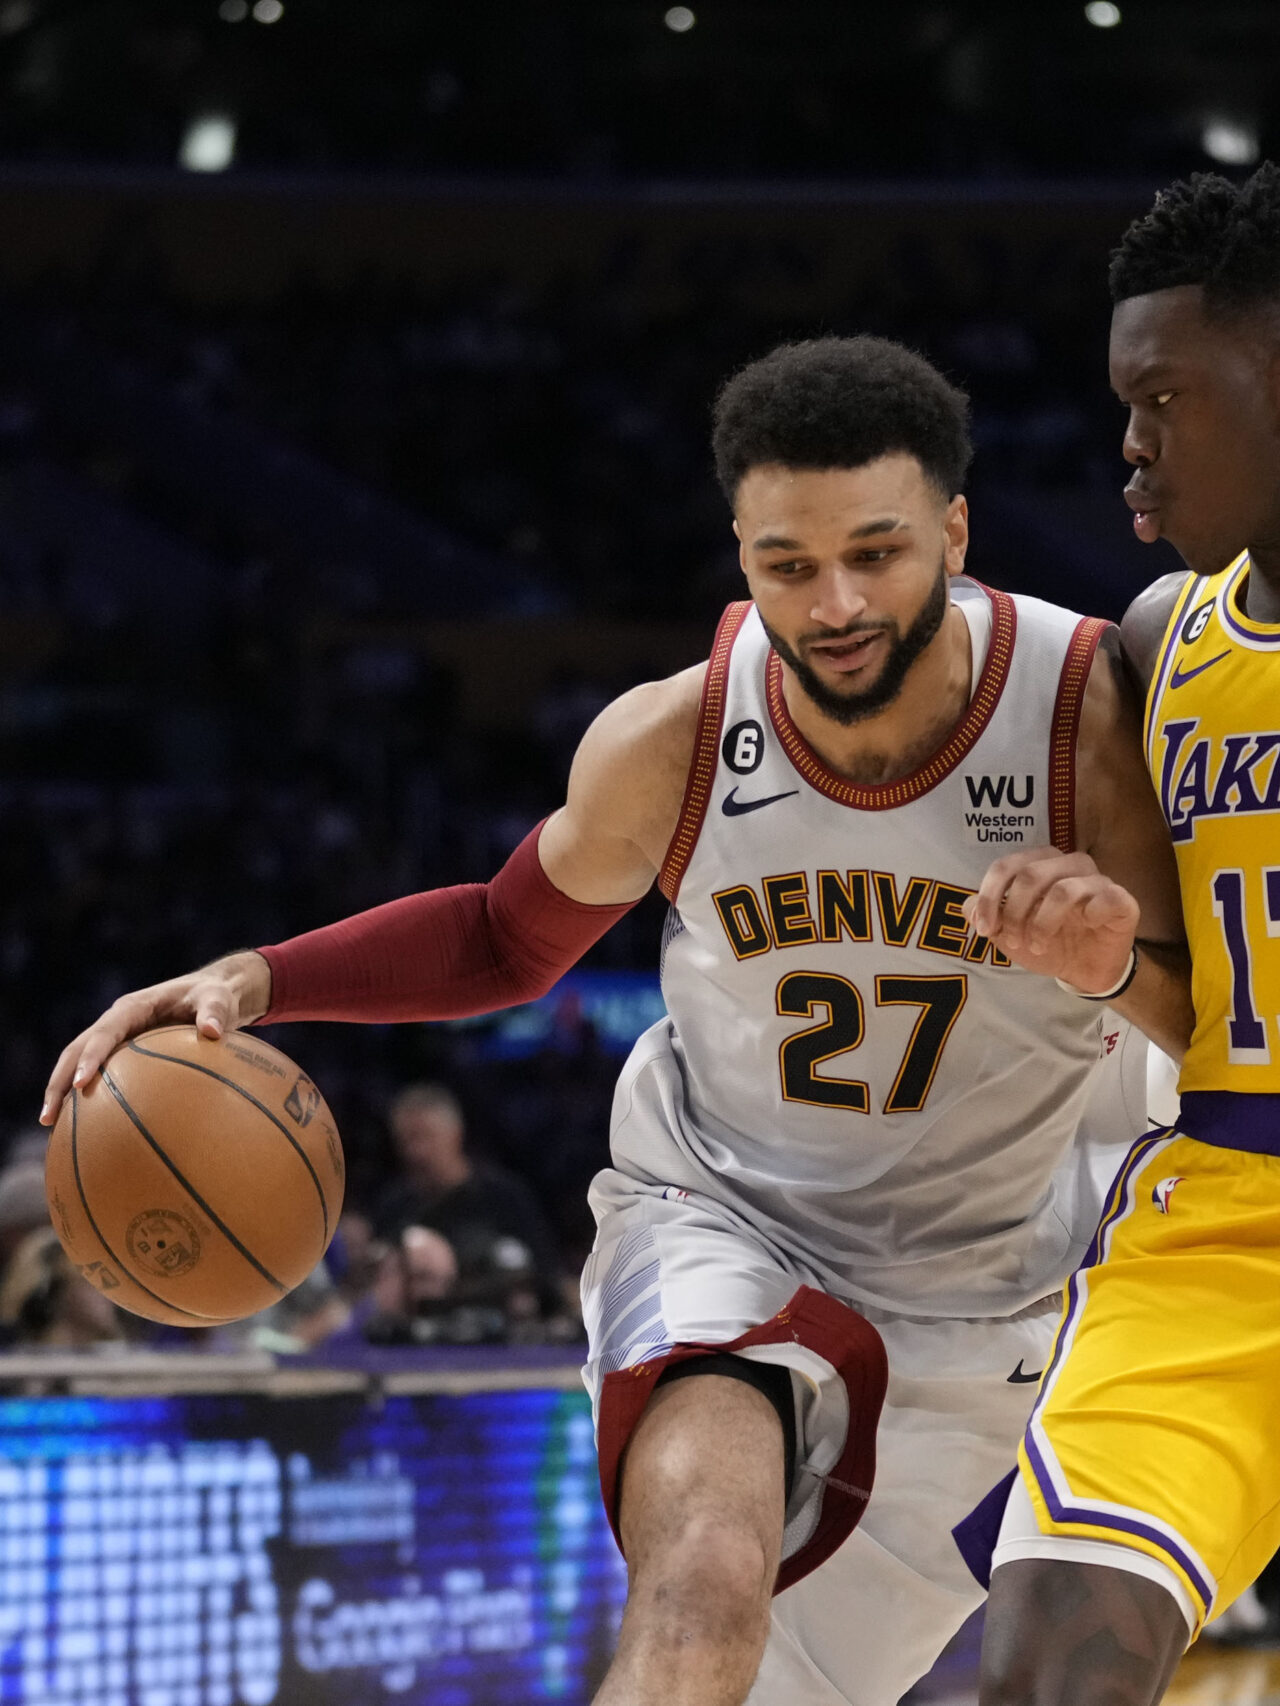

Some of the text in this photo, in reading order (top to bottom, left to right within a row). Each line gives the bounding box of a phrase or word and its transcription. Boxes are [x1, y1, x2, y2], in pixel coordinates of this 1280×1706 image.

[734, 728, 759, 769] 6
[965, 775, 1034, 808] WU
[965, 813, 1034, 827] Western
[977, 827, 1024, 842] Union
[775, 969, 968, 1114] 27
